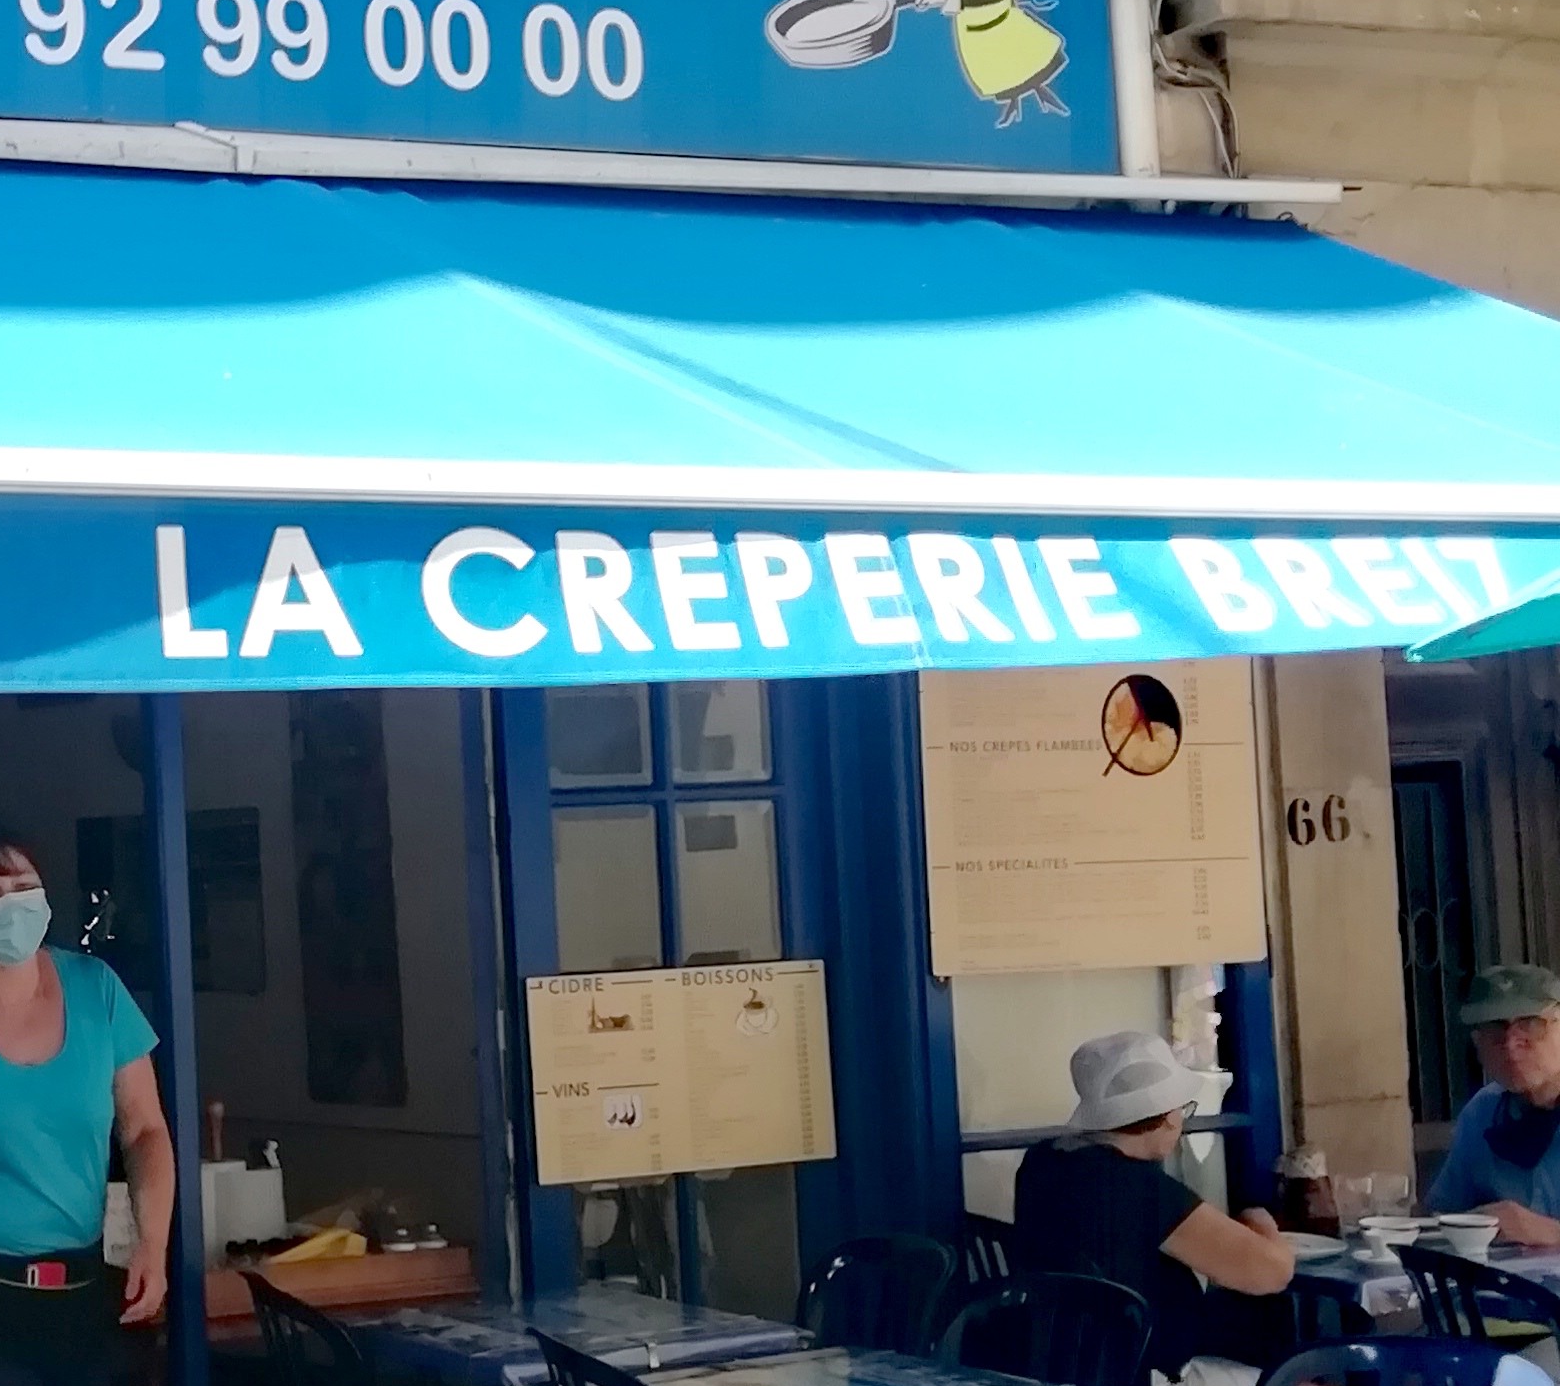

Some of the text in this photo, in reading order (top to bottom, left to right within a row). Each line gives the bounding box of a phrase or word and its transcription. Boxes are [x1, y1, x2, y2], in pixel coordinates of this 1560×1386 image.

[524, 5, 642, 100] 00
[158, 527, 363, 657] LA
[422, 529, 1141, 657] CREPERIE
[949, 741, 977, 753] NOS
[982, 740, 1031, 753] CREPES
[1287, 794, 1351, 846] 66
[956, 858, 1069, 872] NOS SPECIALITES
[549, 977, 604, 994] CIDRE
[681, 968, 774, 986] BOISSONS
[552, 1082, 590, 1098] VINS
